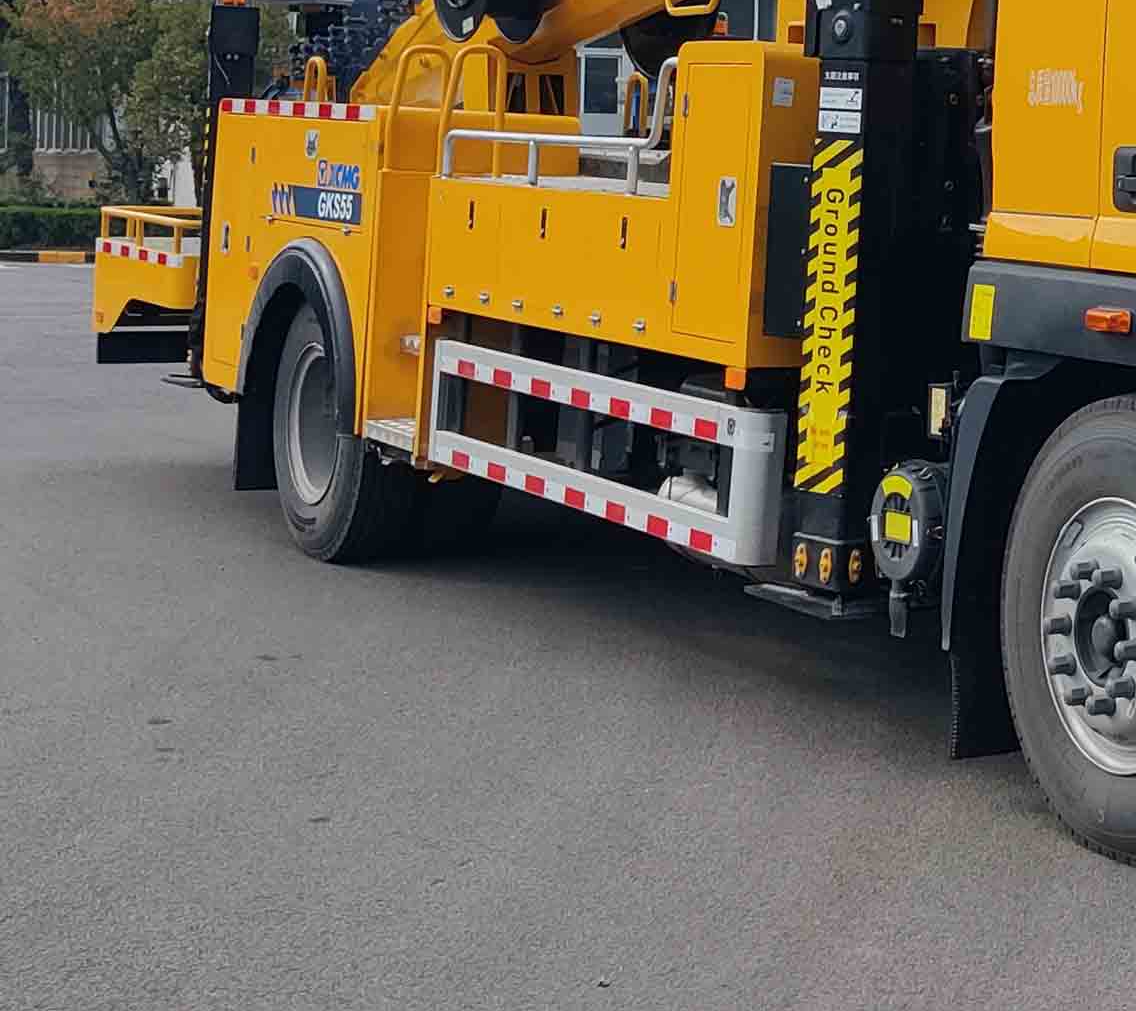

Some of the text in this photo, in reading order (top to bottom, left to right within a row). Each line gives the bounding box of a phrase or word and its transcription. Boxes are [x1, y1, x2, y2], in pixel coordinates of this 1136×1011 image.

[329, 164, 360, 189] XCMG
[317, 191, 353, 220] GKS55
[814, 187, 846, 395] Ground Check
